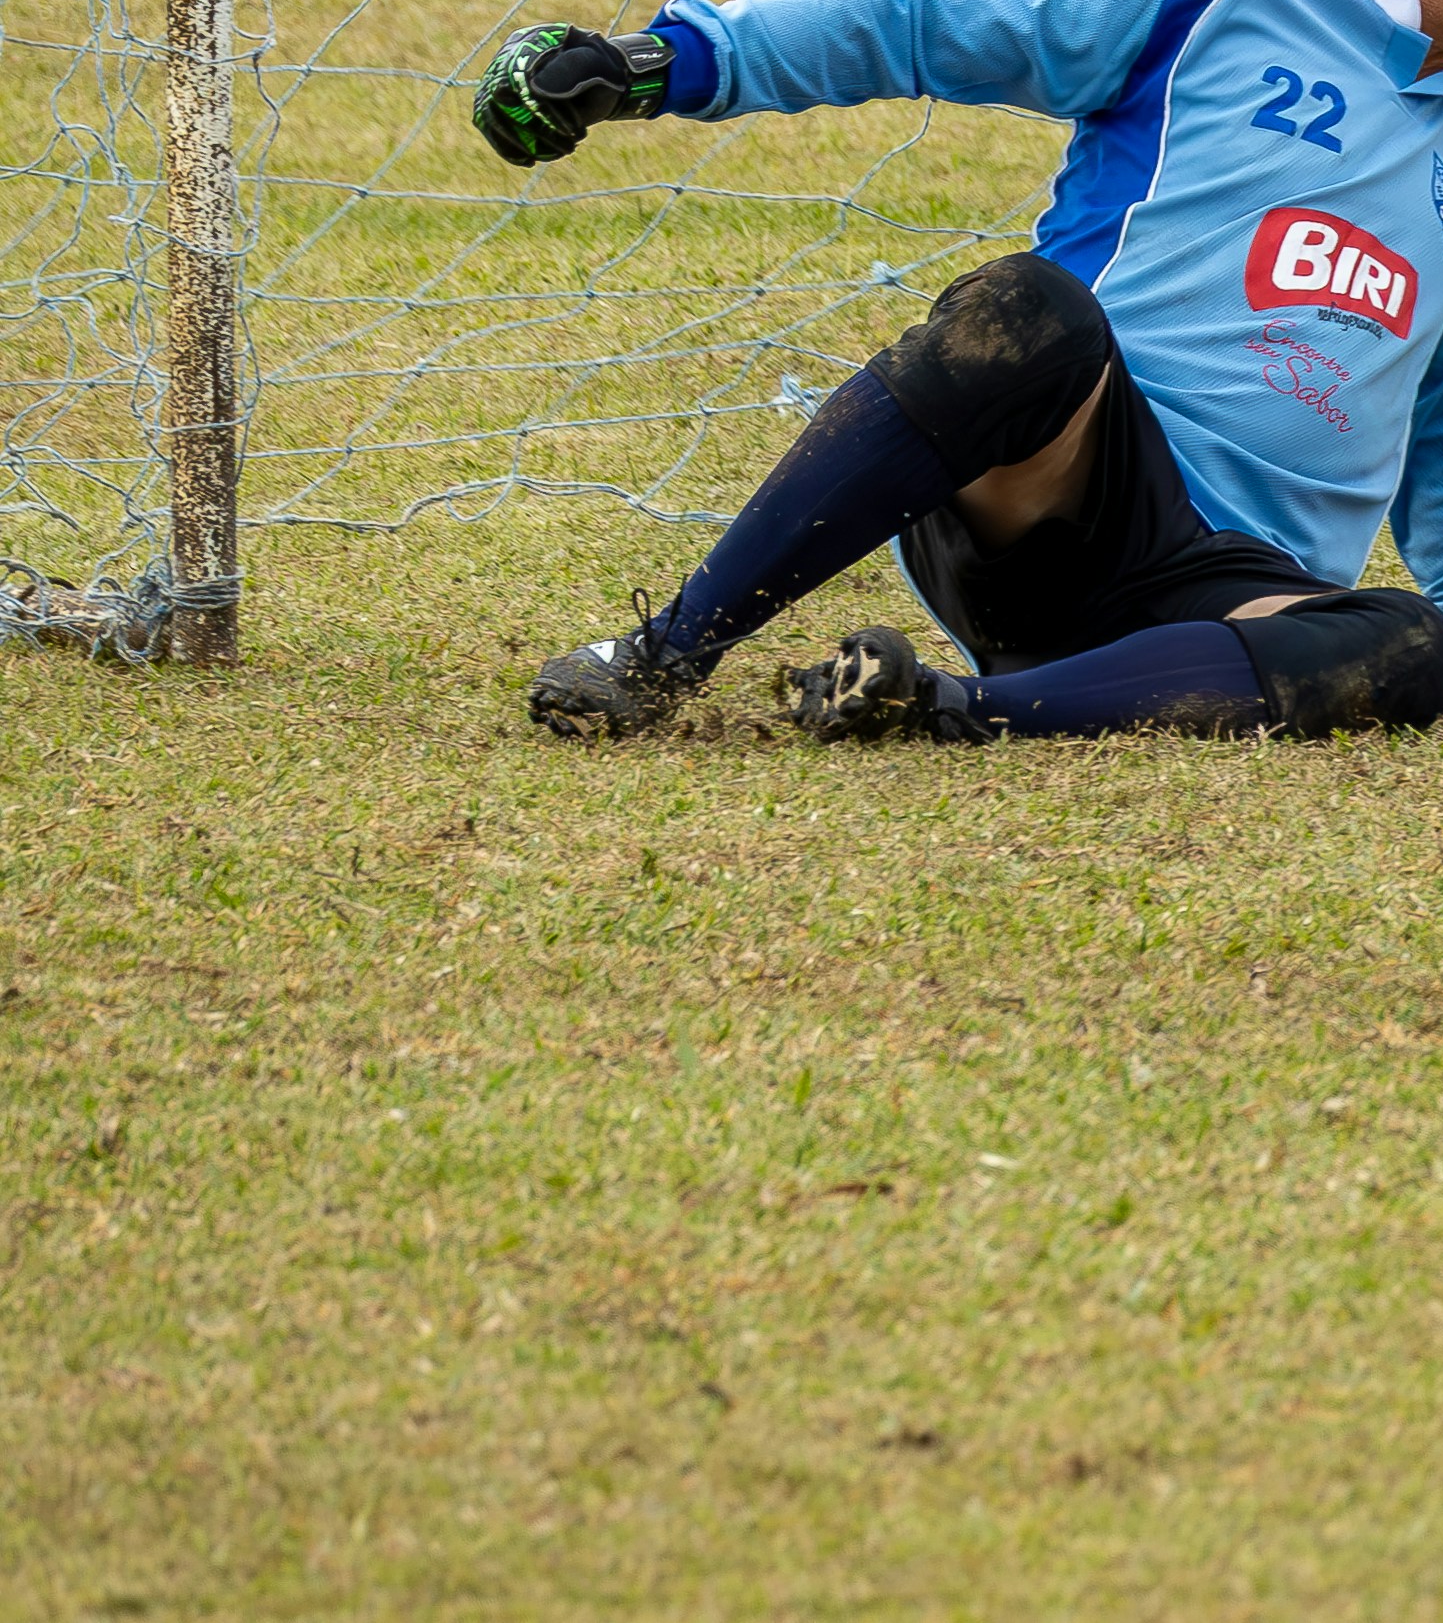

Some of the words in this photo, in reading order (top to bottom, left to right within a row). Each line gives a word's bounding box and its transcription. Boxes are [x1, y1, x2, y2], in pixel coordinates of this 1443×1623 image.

[1249, 65, 1347, 155] 22
[1271, 220, 1407, 319] BIRI
[1262, 354, 1354, 434] Sabor
